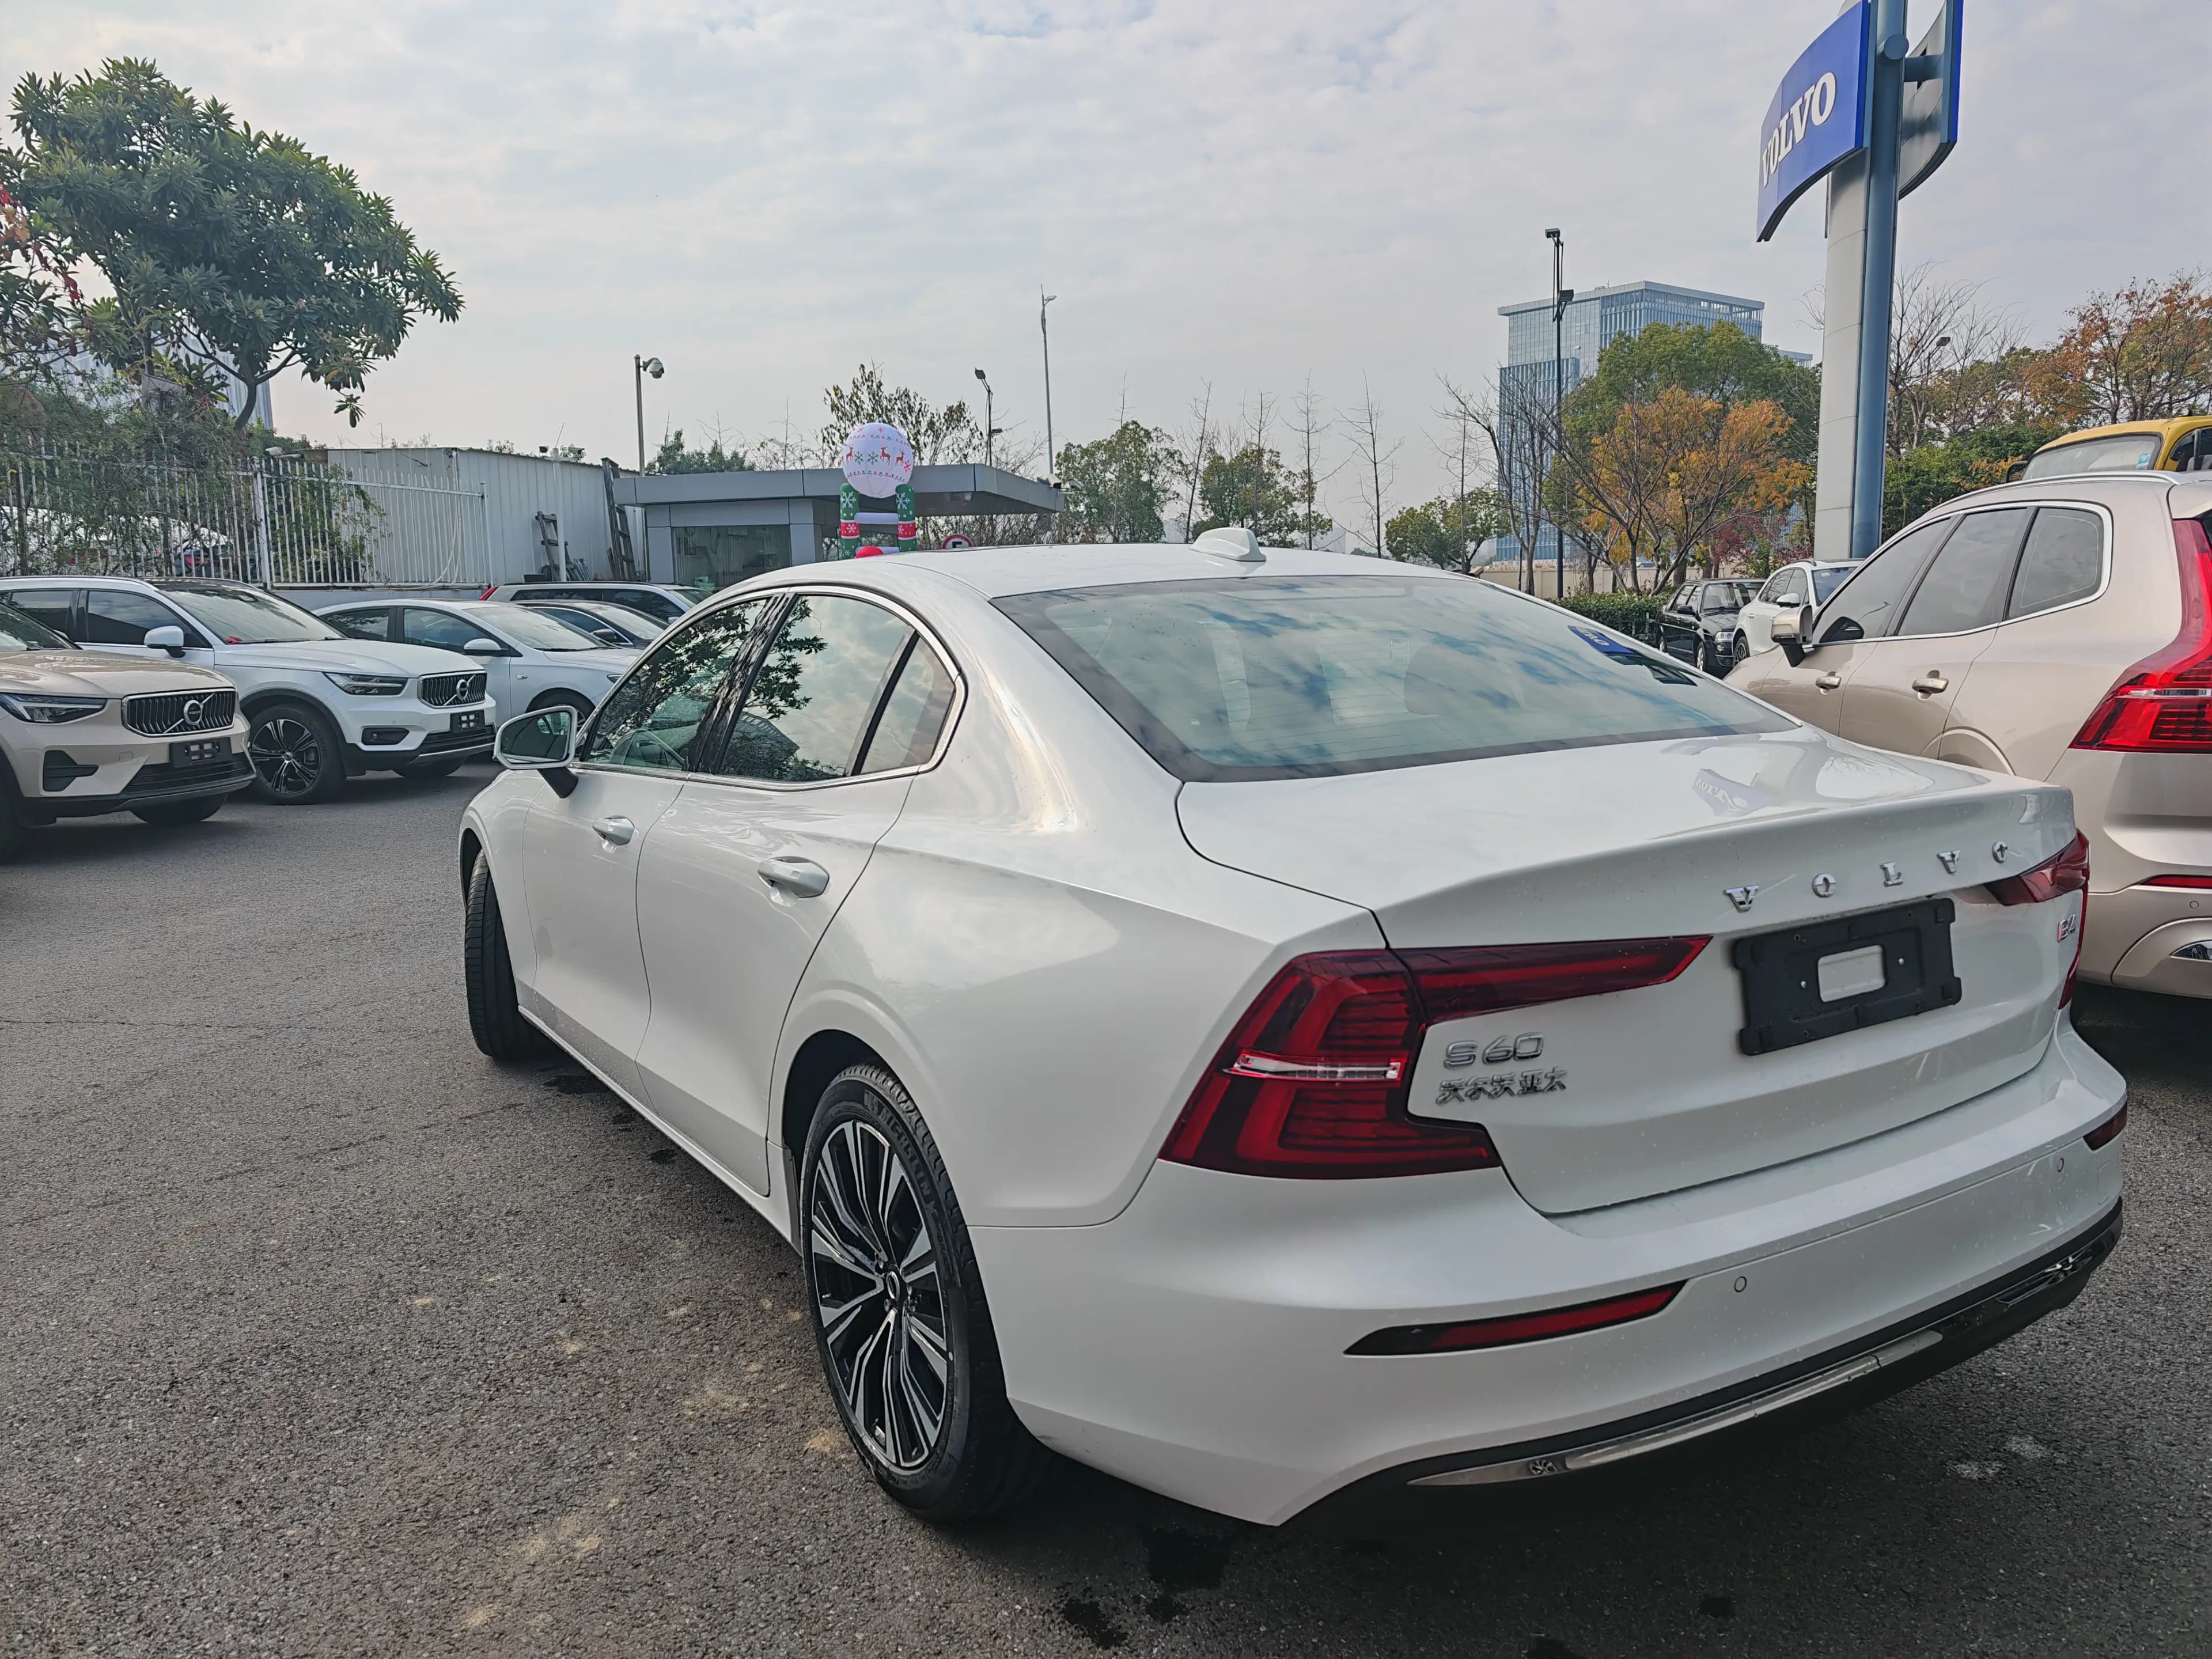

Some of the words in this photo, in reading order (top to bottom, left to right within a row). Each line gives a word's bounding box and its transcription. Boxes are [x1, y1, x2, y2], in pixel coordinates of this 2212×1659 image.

[1762, 71, 1836, 189] VOLVO
[1724, 840, 2008, 913] VOLVO
[2057, 914, 2076, 943] B4
[1444, 1032, 1544, 1069] S60
[1435, 1066, 1567, 1106] 沃尔沃亚太
